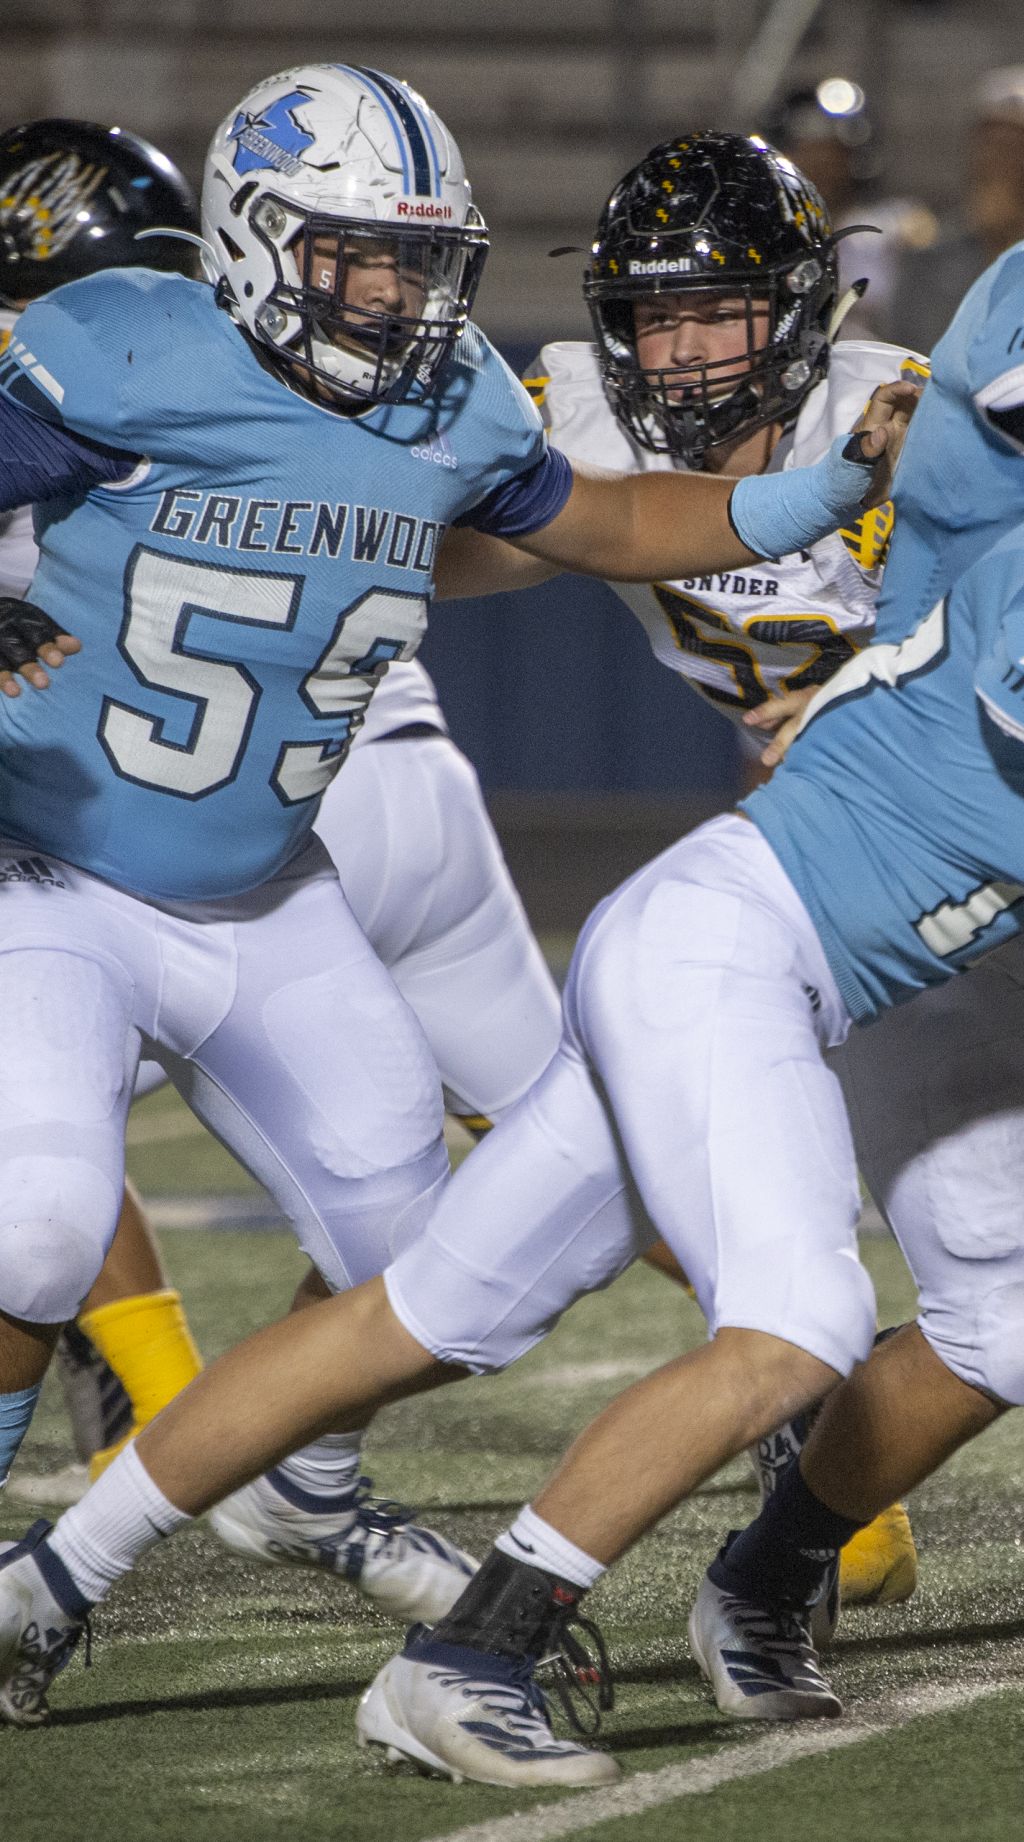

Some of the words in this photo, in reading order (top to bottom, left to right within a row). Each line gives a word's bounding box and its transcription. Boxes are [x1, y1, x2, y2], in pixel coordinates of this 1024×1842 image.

[397, 201, 453, 220] Riddell
[629, 258, 691, 275] Riddell
[149, 489, 447, 574] GREENWOO
[683, 573, 779, 596] SNYDER
[97, 541, 431, 808] 59
